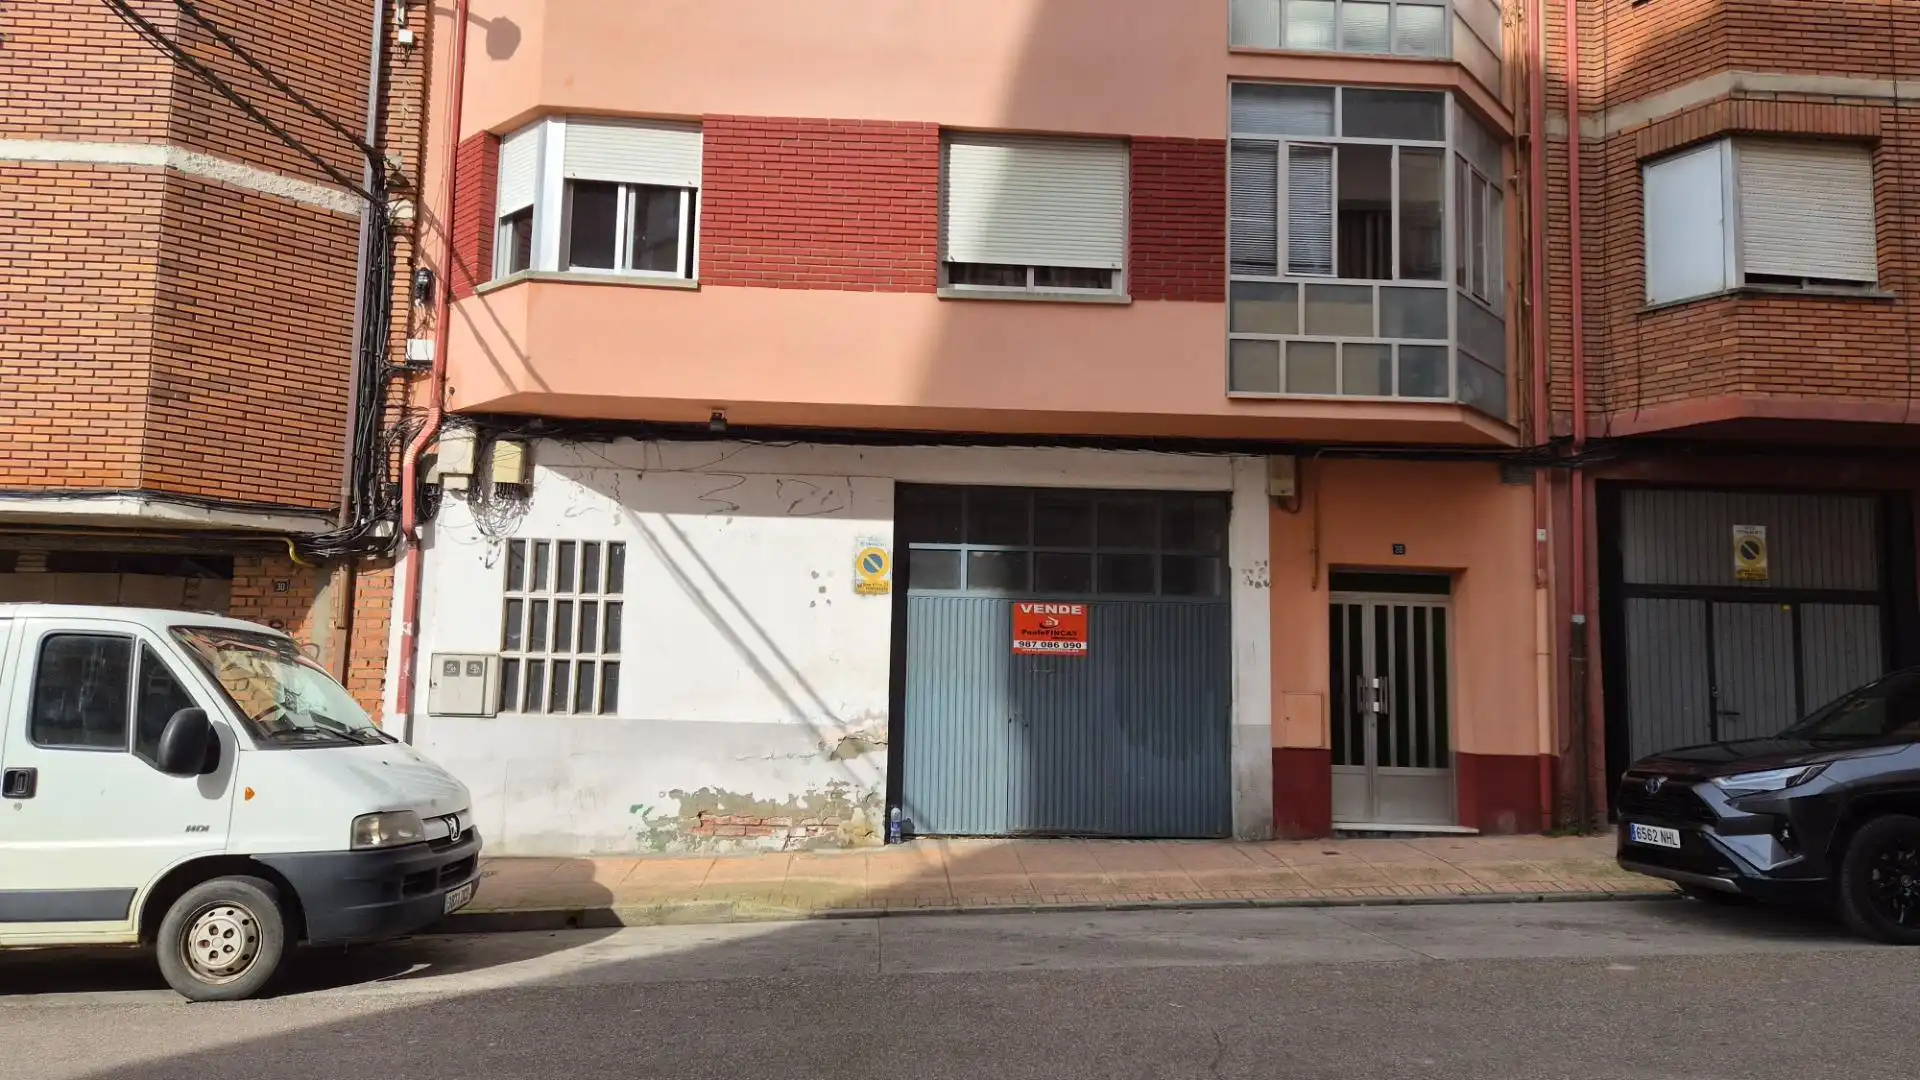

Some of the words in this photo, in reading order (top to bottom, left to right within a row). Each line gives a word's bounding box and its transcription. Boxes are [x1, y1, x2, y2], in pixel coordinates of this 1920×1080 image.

[1020, 604, 1083, 615] VENDE
[1040, 641, 1060, 649] 086
[1636, 827, 1659, 843] 6562
[1660, 830, 1679, 846] NHL
